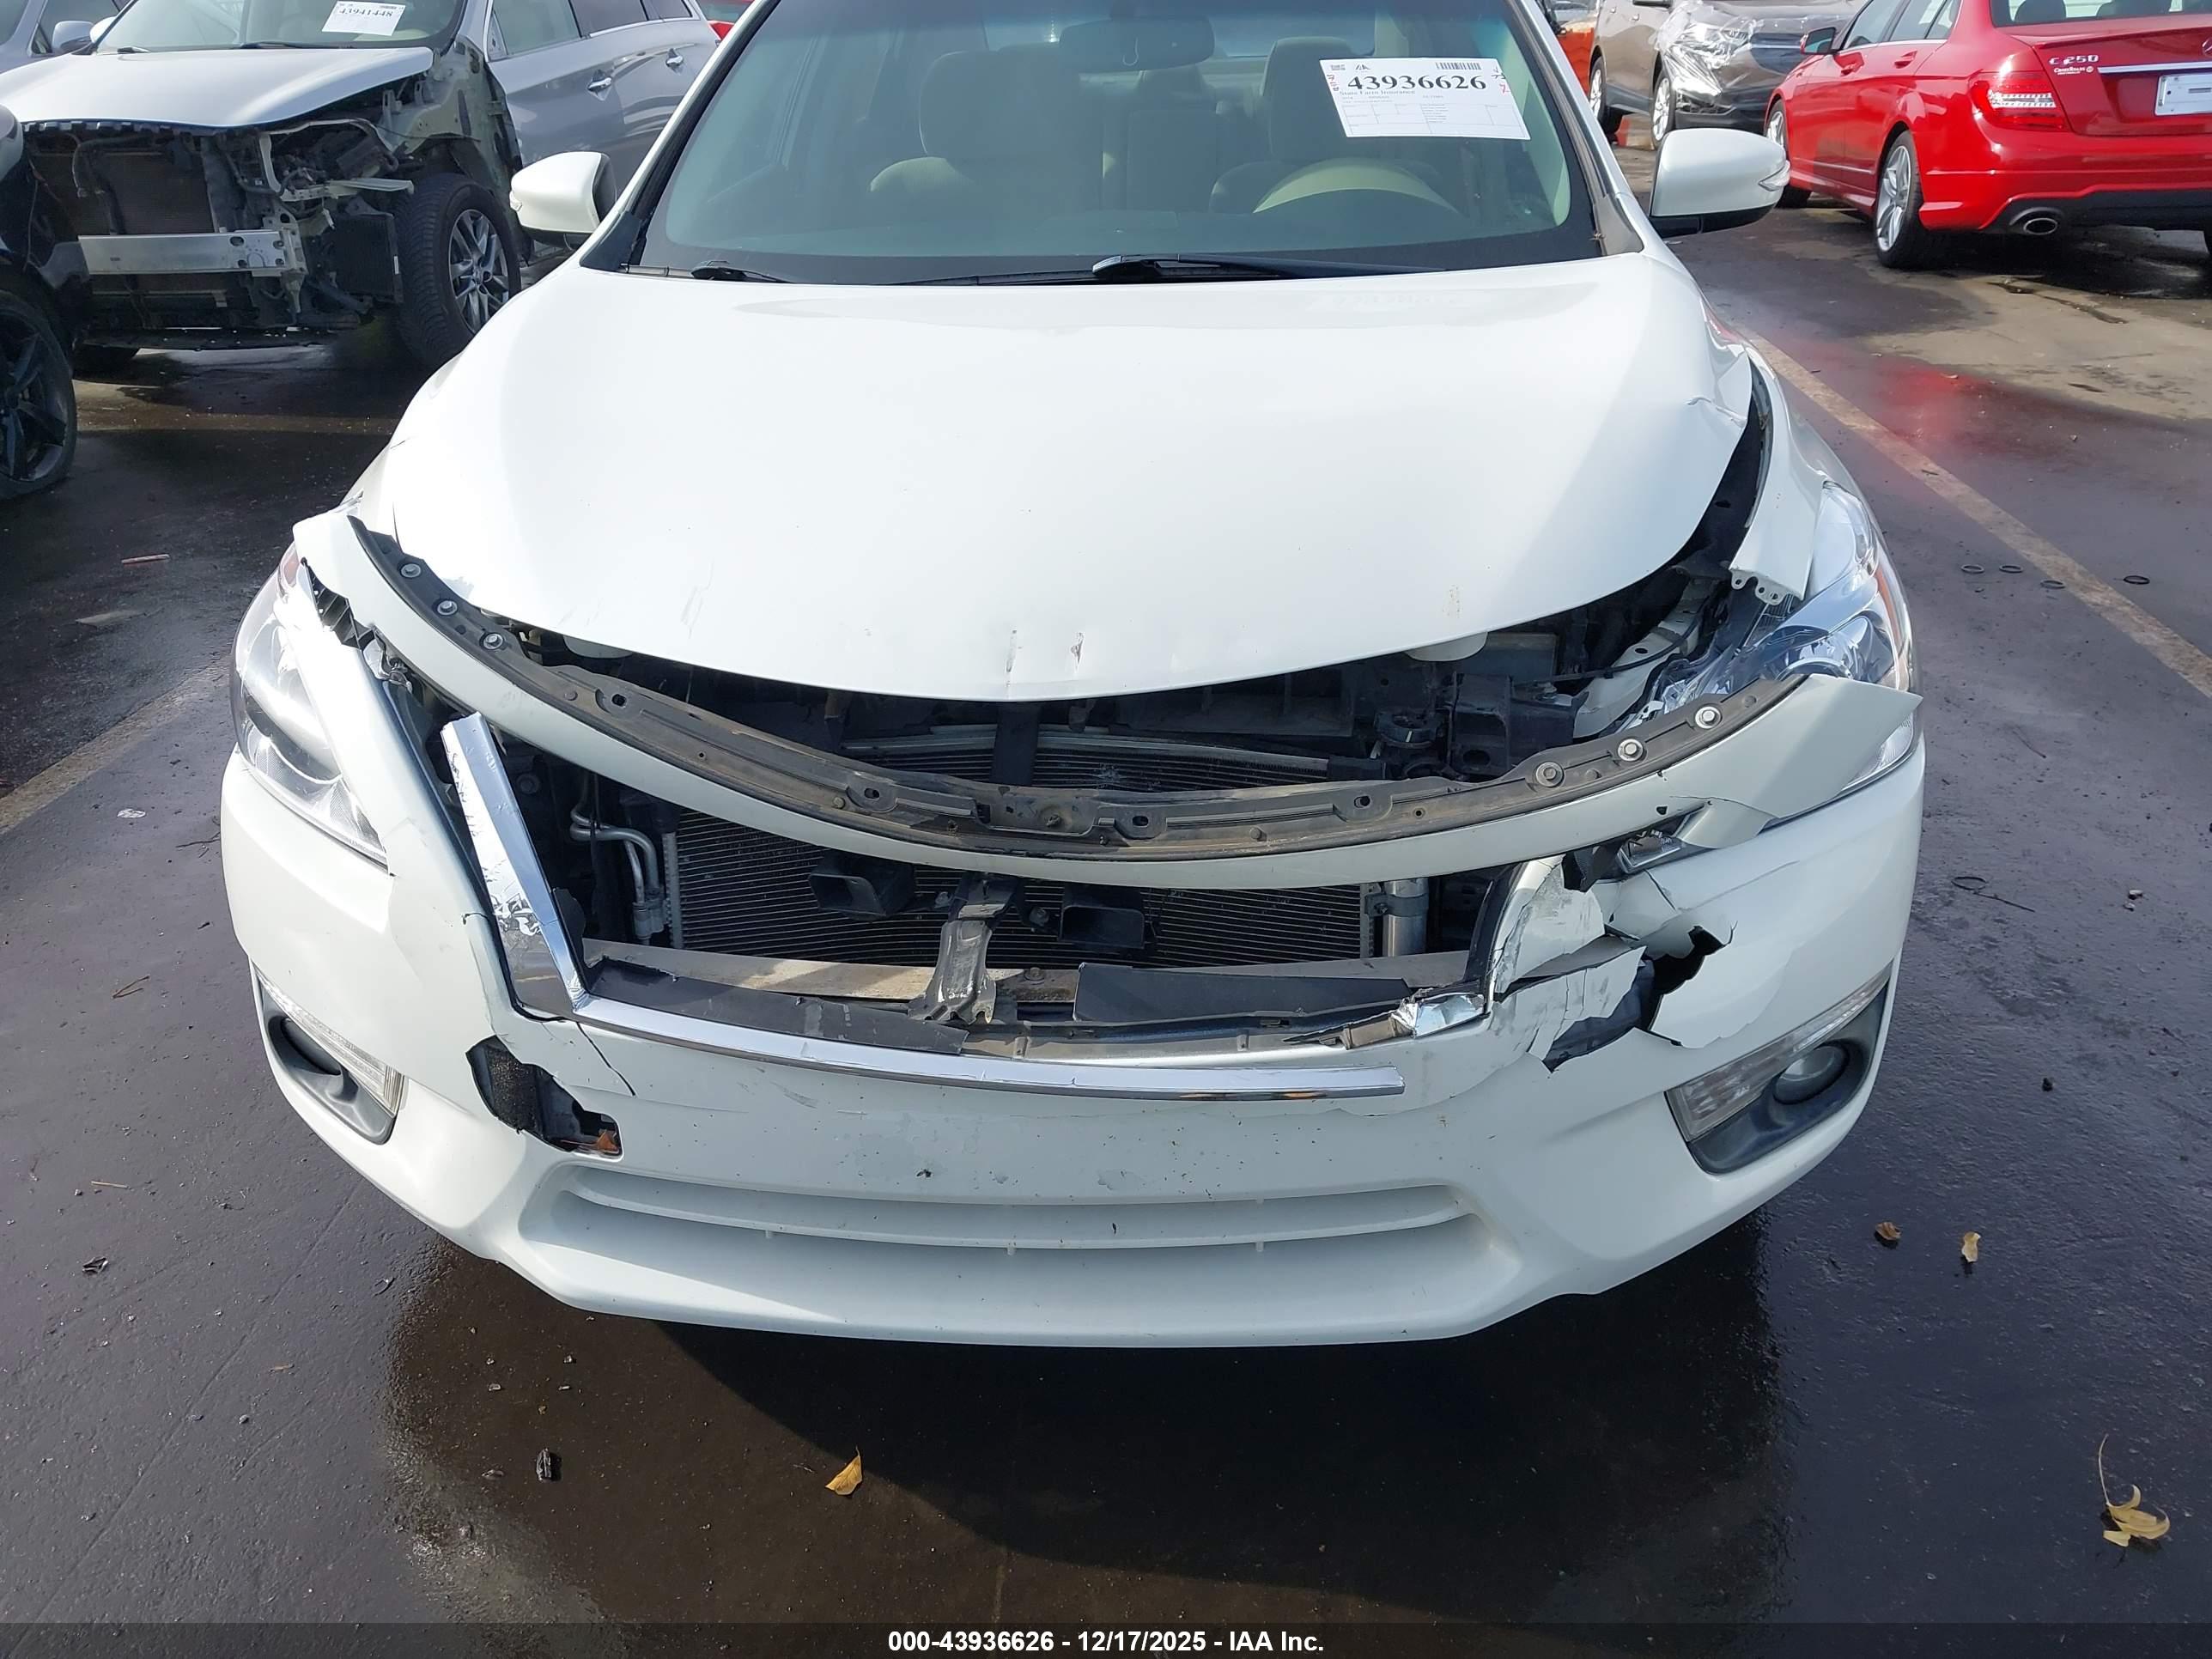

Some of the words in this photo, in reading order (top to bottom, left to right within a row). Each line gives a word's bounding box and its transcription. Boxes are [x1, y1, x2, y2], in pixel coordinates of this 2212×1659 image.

[2049, 57, 2060, 65] C
[2063, 55, 2099, 65] 250
[1347, 75, 1486, 90] 43936626
